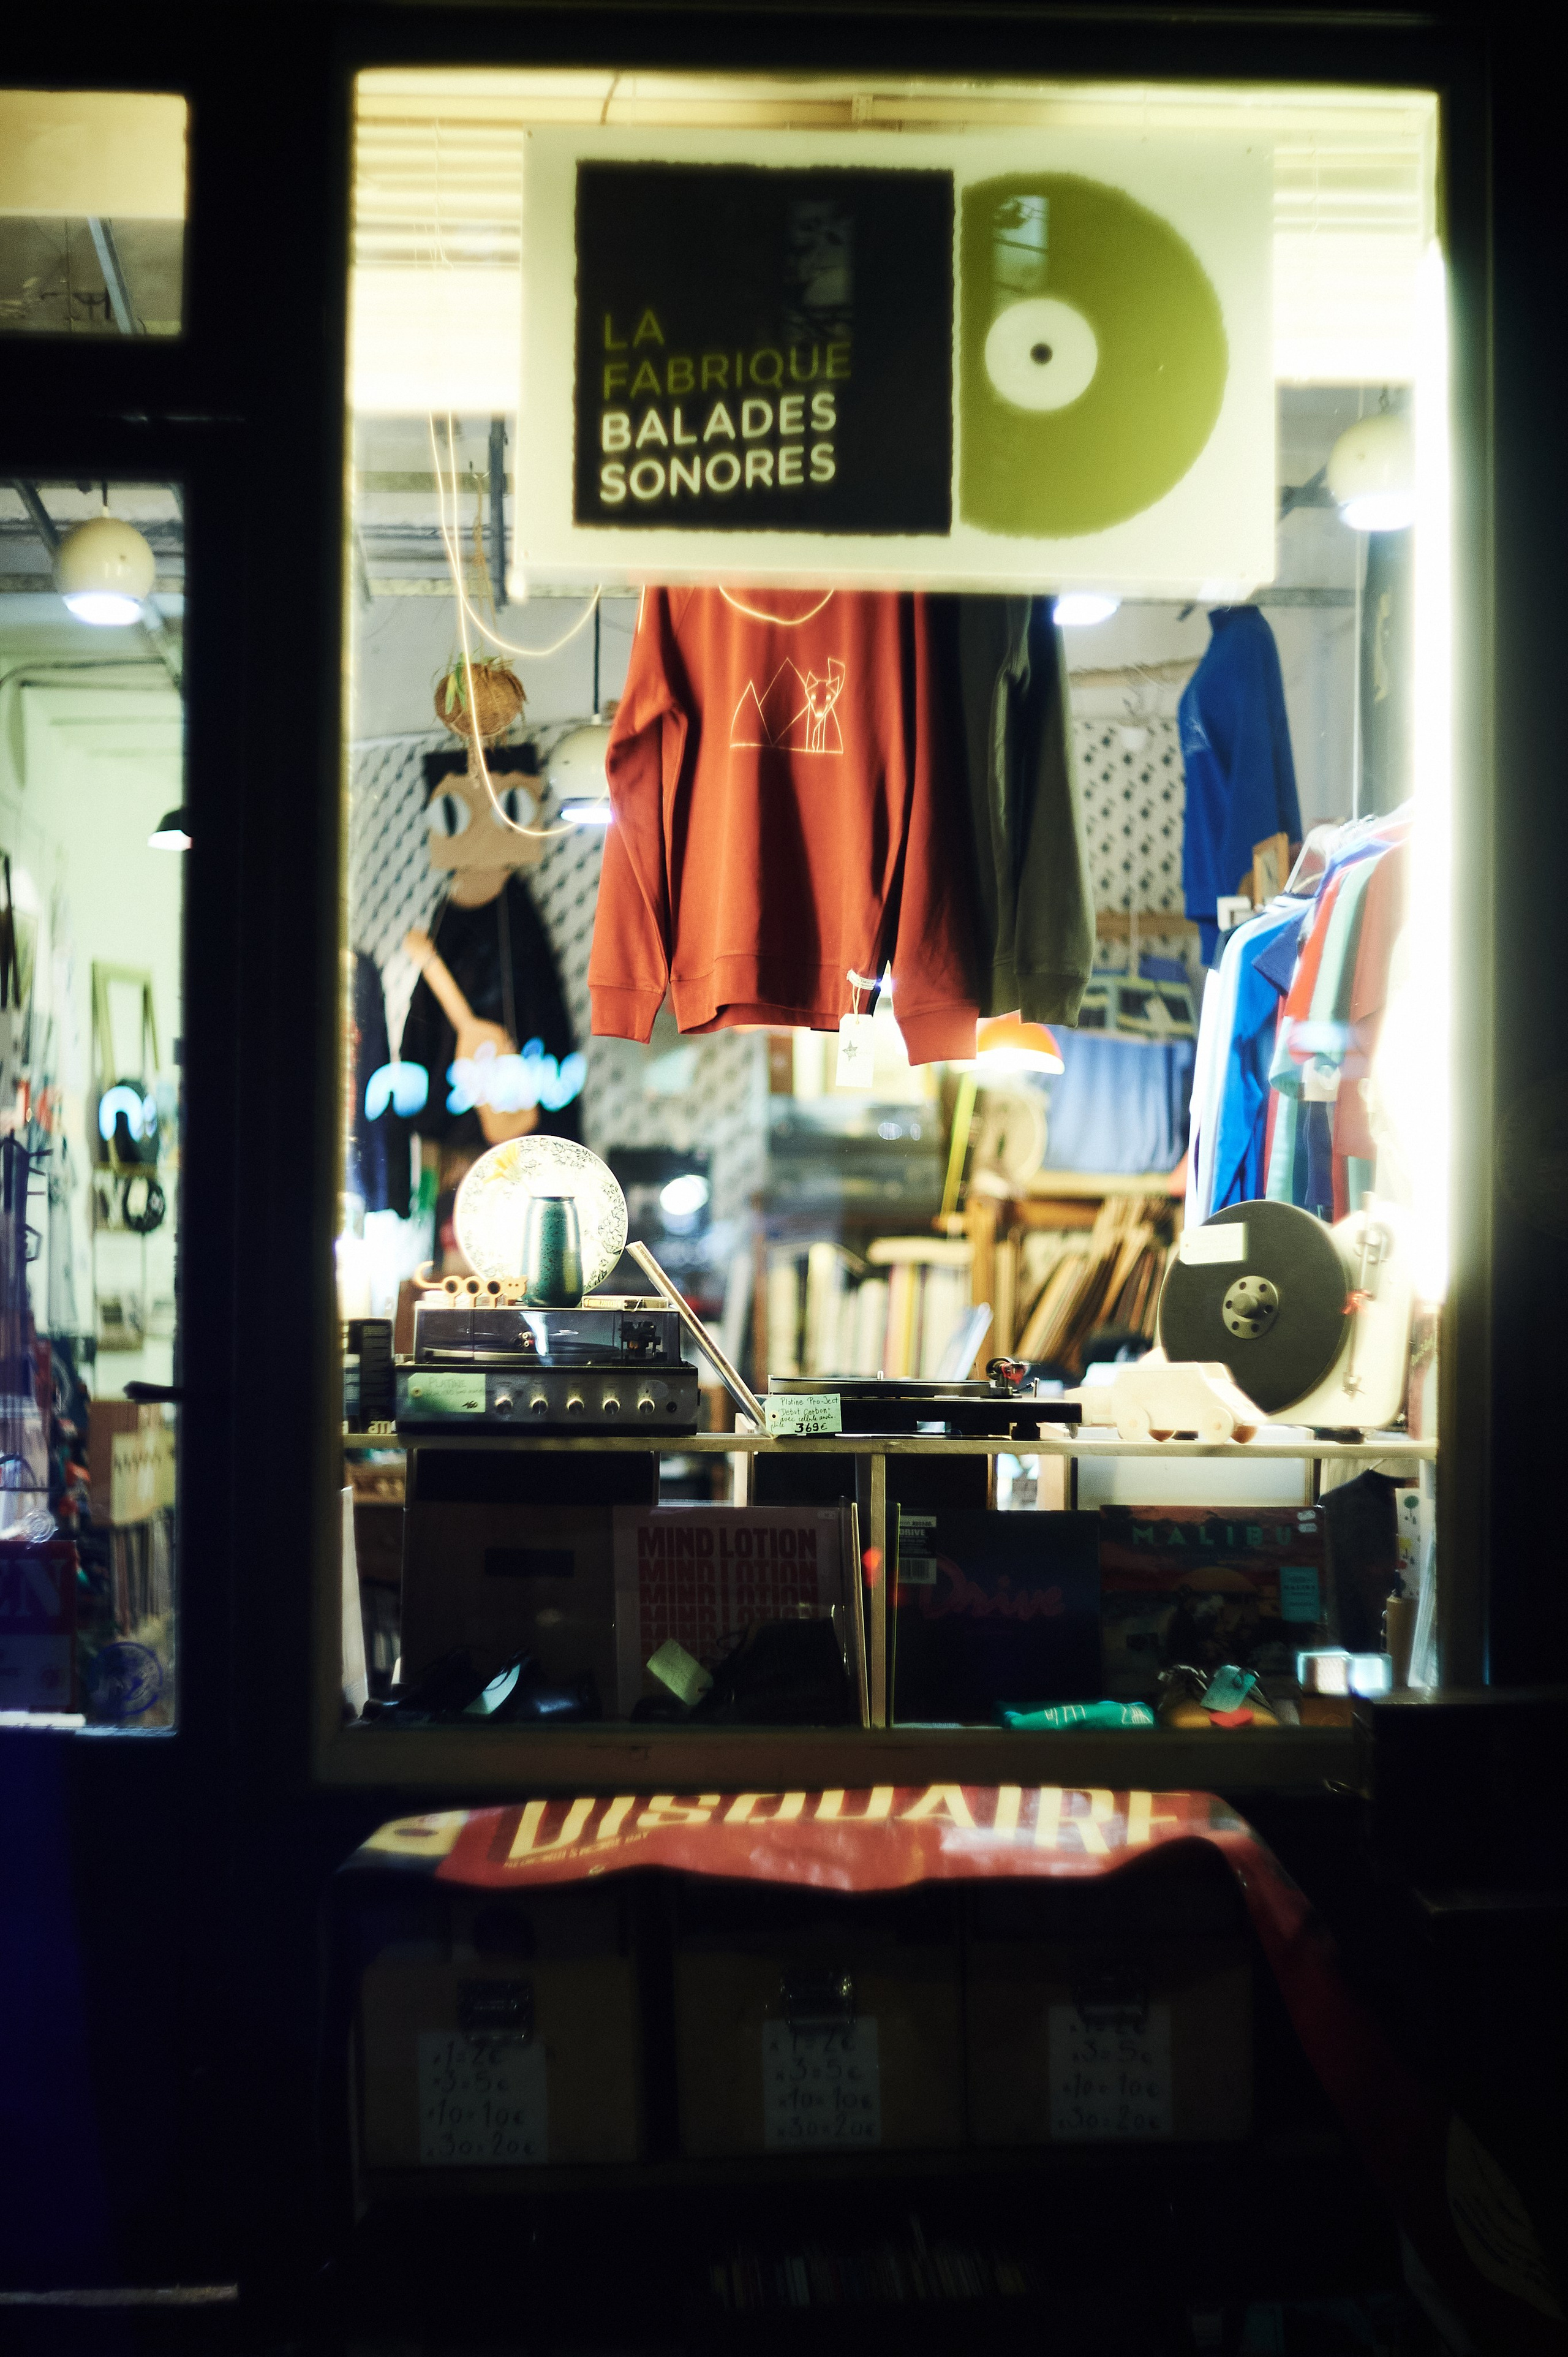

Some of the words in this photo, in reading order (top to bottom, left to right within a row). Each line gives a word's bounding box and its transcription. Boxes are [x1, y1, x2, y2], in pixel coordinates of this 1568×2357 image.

[603, 308, 665, 350] LA
[603, 341, 852, 401] FABRIQUE
[601, 391, 838, 453] BALADES
[600, 442, 837, 503] SONORES
[780, 1397, 804, 1405] Platine
[638, 1527, 715, 1559] MIND
[719, 1527, 817, 1559] LOTION
[1131, 1524, 1292, 1547] MALIBU
